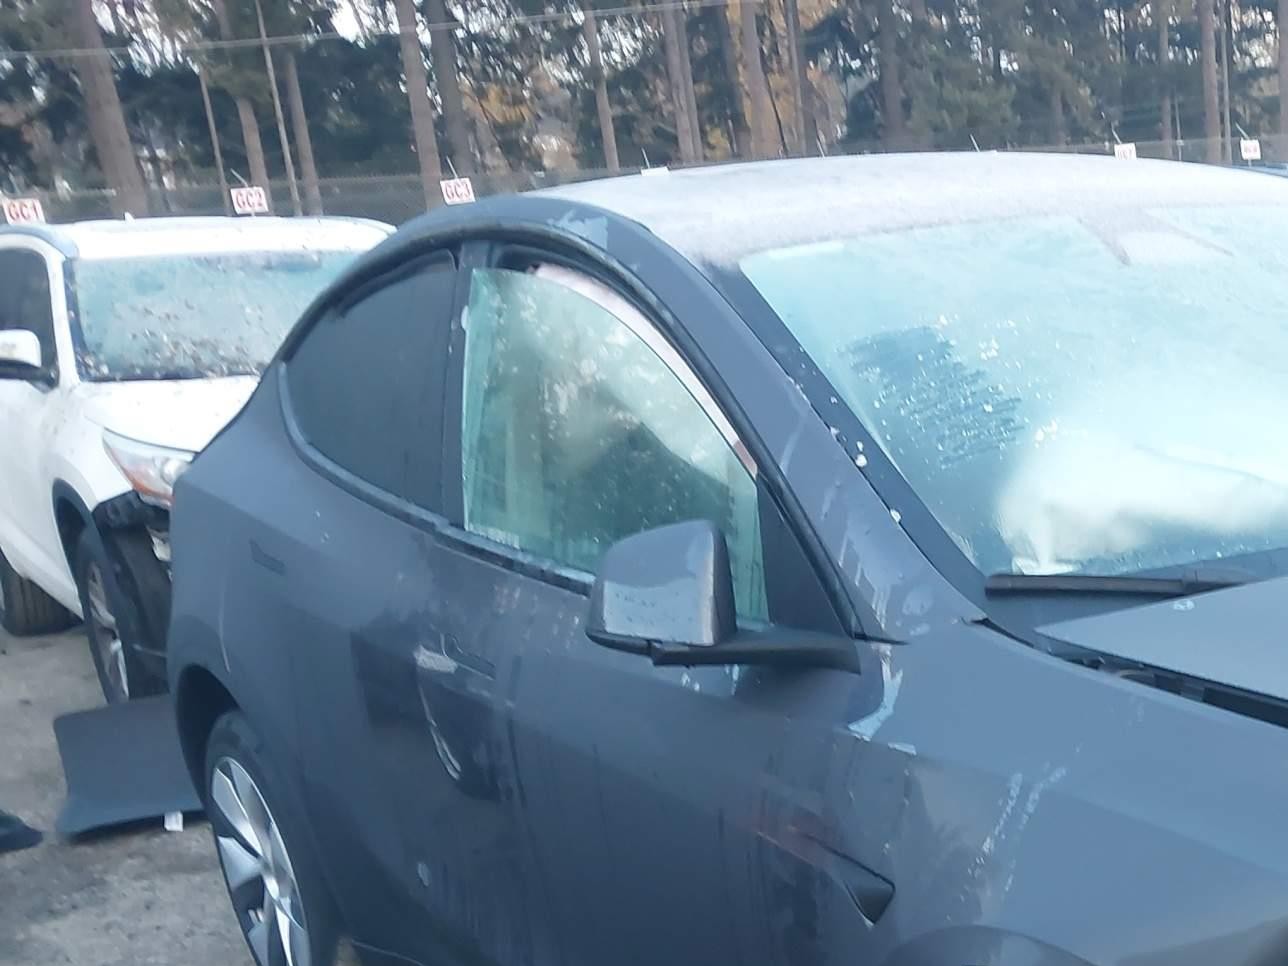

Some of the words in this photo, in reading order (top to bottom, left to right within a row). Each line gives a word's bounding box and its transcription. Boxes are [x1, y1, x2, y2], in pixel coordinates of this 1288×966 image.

[236, 191, 263, 209] GC2
[445, 181, 471, 201] GC3
[8, 200, 39, 222] GC1
